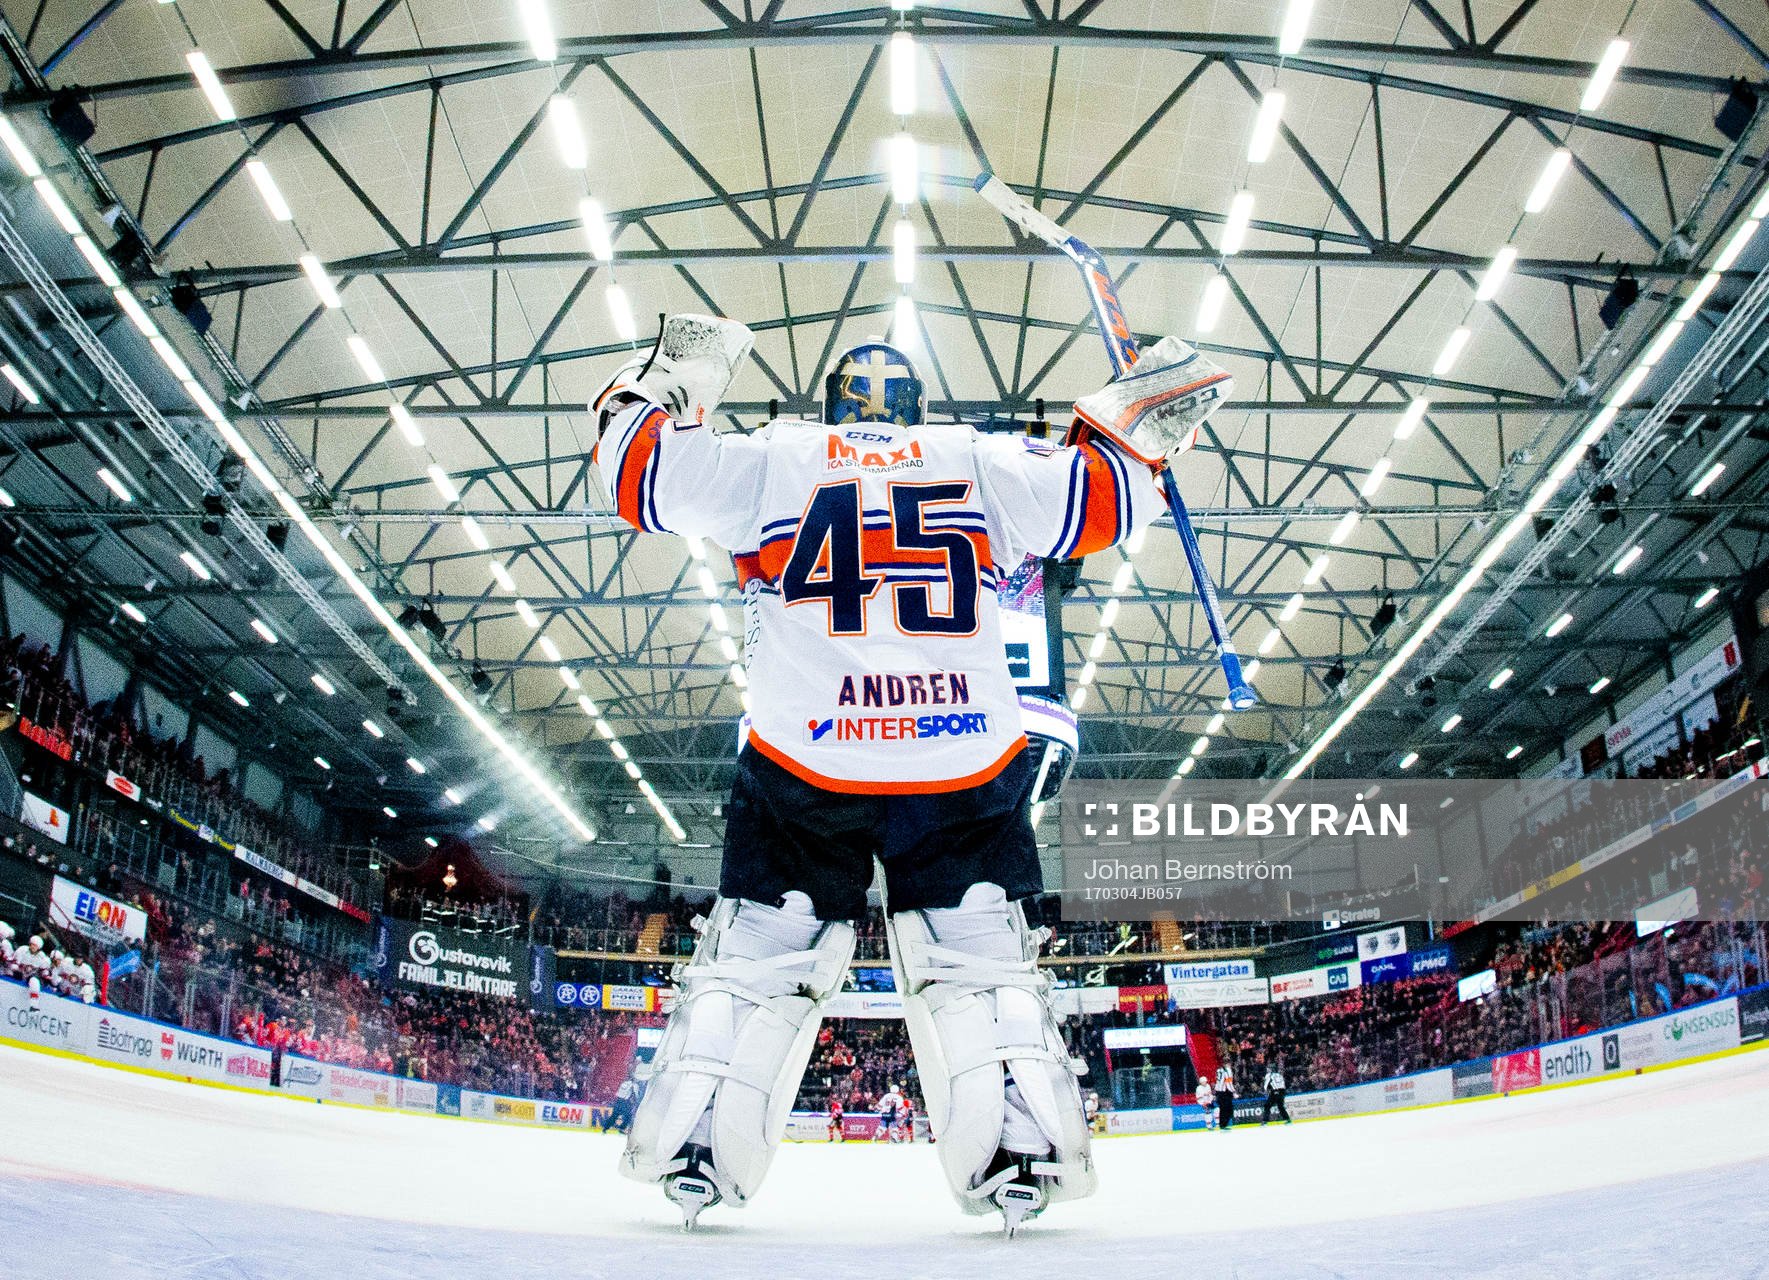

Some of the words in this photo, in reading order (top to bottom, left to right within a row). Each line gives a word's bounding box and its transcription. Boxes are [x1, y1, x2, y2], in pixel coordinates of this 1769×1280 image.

[828, 434, 922, 468] MAXI
[846, 431, 893, 443] CCM
[827, 460, 844, 470] ICA
[845, 457, 924, 474] STRMARKNAD
[780, 478, 981, 637] 45
[837, 712, 988, 741] INTERSPORT
[75, 891, 127, 929] ELON
[409, 931, 512, 974] Gustavsvik
[1412, 956, 1447, 972] KPMG
[1171, 964, 1249, 979] Vintergatan
[177, 1041, 224, 1069] WÜRTH
[542, 1105, 583, 1124] ELON
